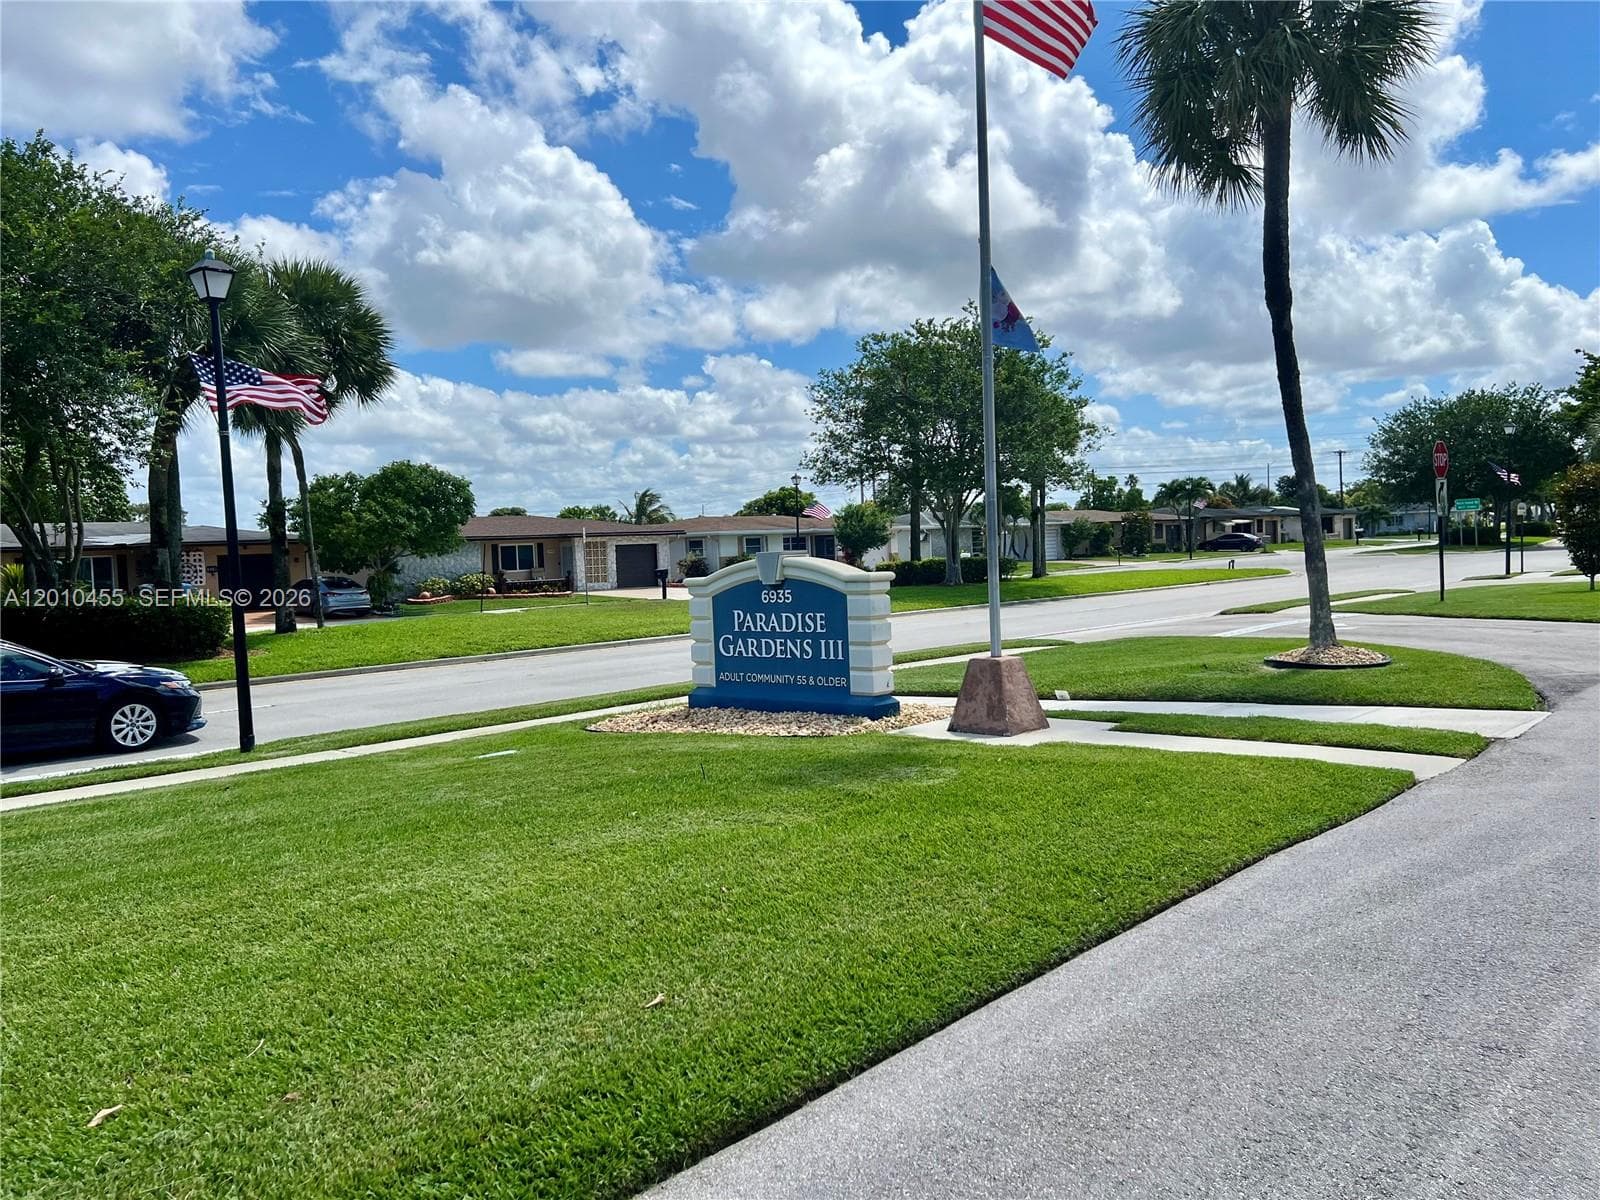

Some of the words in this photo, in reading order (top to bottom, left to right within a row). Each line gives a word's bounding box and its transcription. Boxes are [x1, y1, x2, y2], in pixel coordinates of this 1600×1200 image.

[1434, 453, 1447, 467] STOP
[761, 589, 792, 603] 6935
[732, 609, 826, 633] PARADISE
[718, 634, 813, 660] GARDENS
[820, 639, 844, 660] III
[719, 672, 744, 682] ADULT
[746, 672, 795, 685] COMMUNITY
[797, 675, 807, 685] 55
[808, 676, 815, 686] &
[817, 676, 848, 687] OLDER
